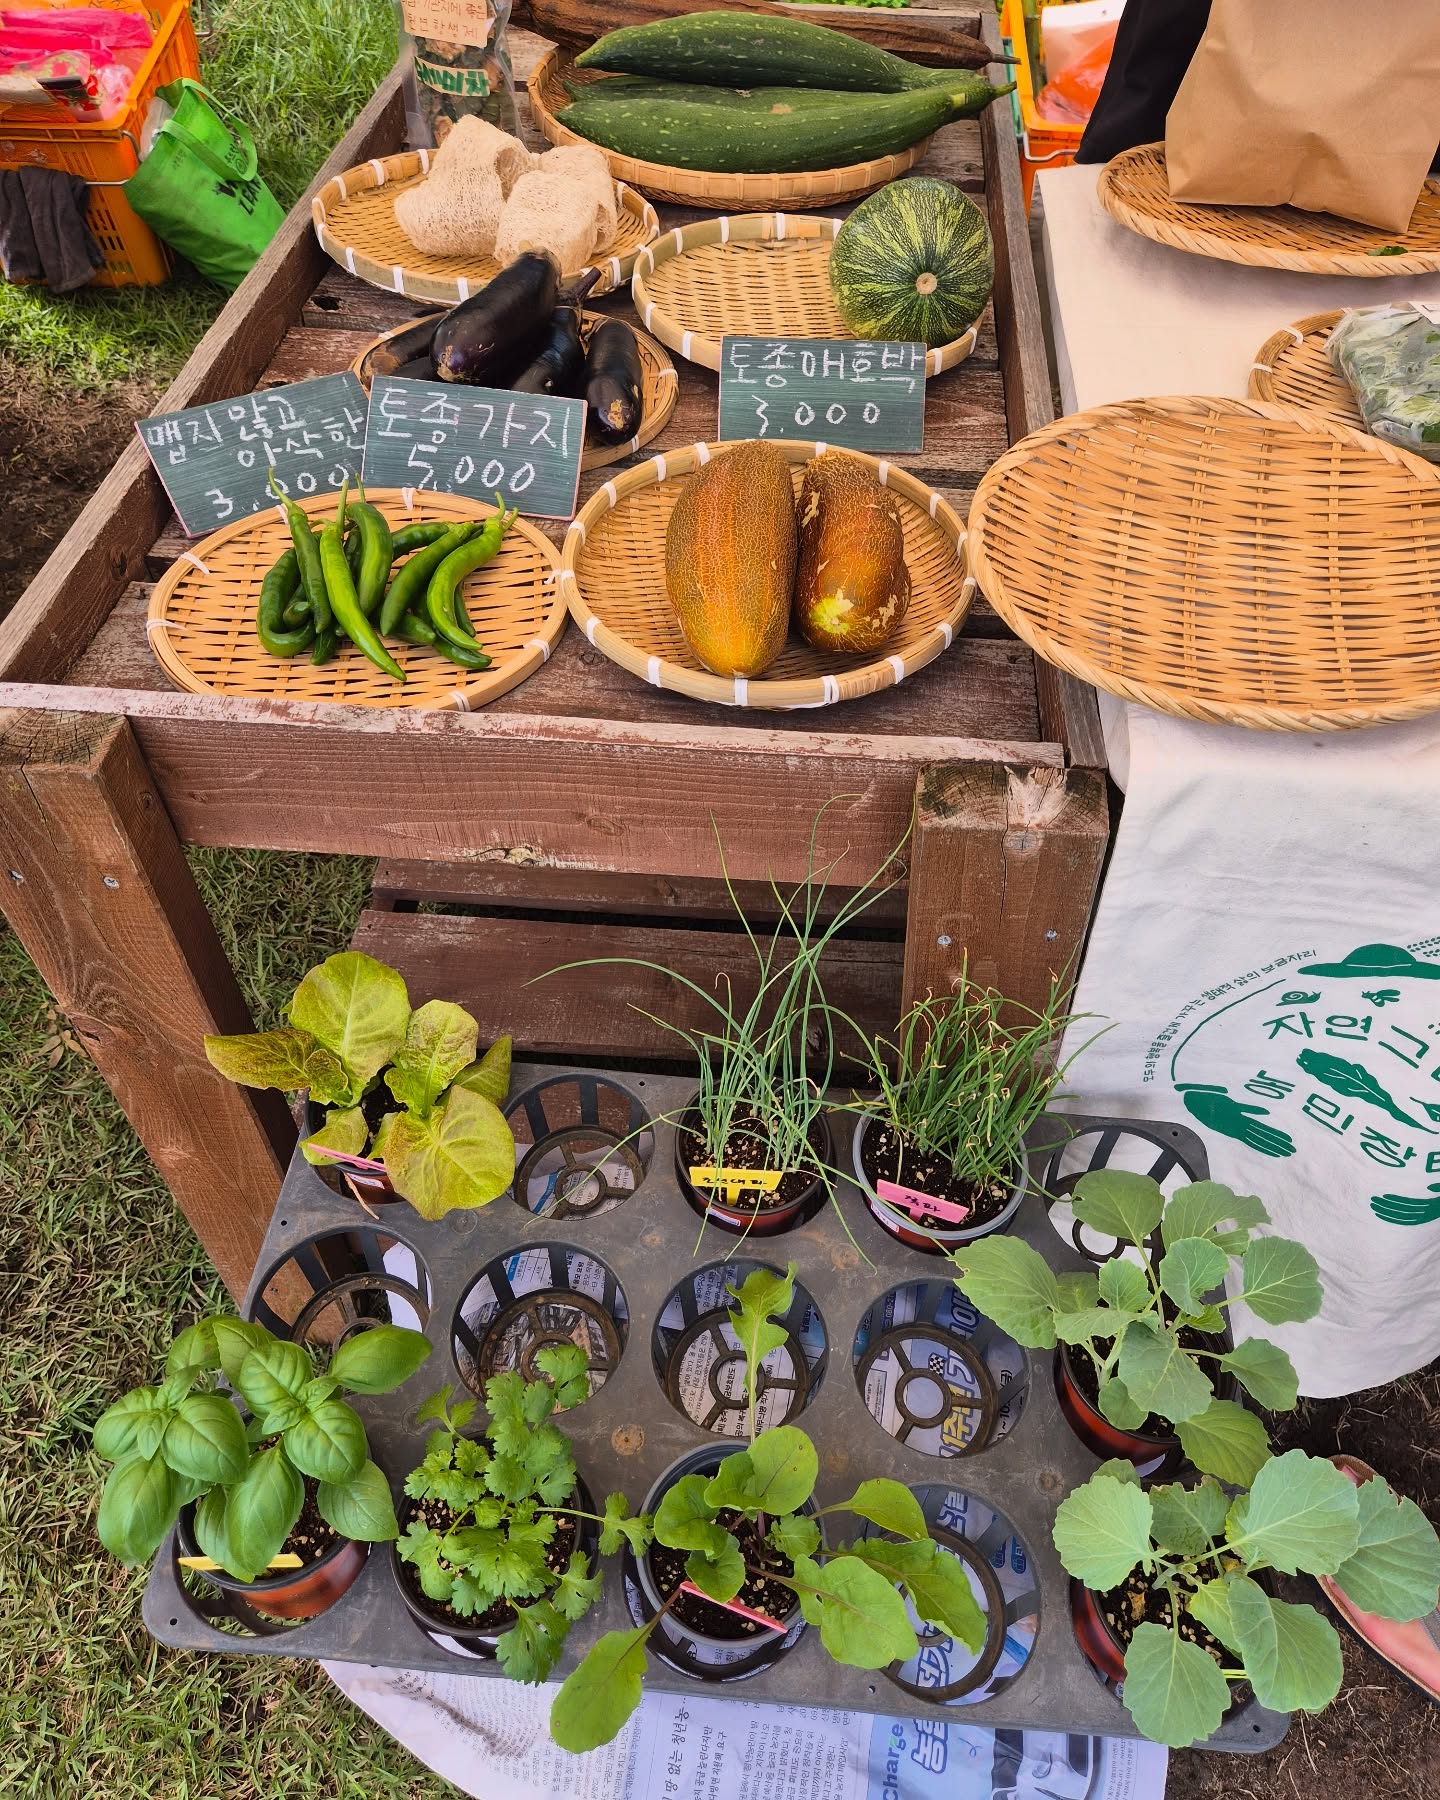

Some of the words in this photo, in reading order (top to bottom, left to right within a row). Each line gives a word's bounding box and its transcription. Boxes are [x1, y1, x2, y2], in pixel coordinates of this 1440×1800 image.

[228, 395, 307, 441] 않고
[237, 407, 365, 468] 아삭한
[1260, 949, 1318, 974] 보금자리
[715, 1730, 727, 1751] 요구
[666, 1748, 683, 1775] 없는
[663, 1779, 679, 1793] 땅
